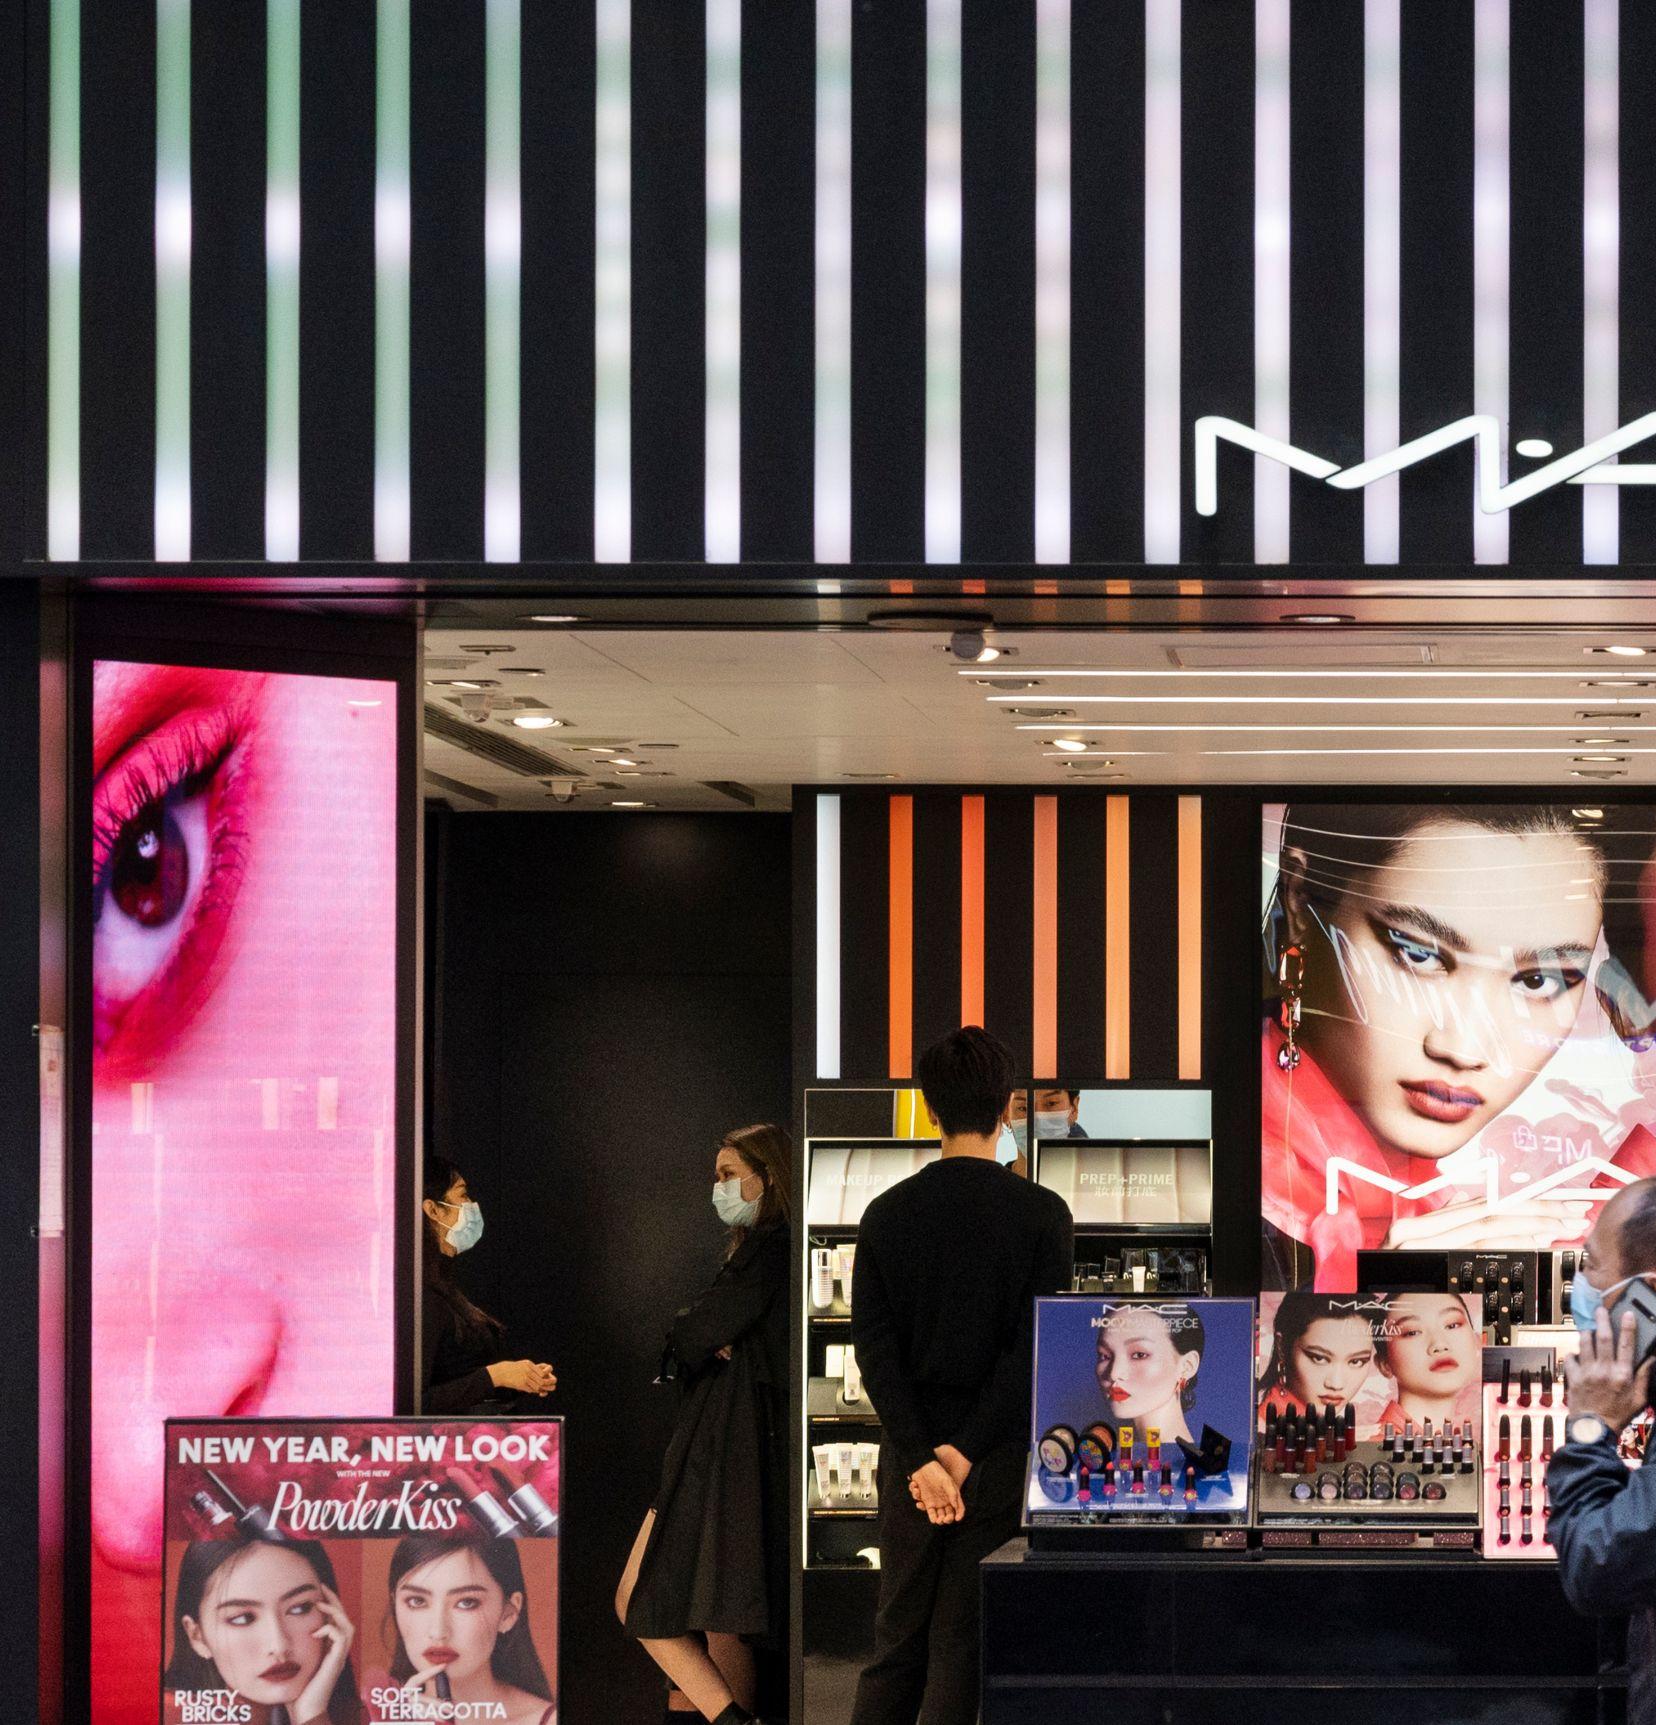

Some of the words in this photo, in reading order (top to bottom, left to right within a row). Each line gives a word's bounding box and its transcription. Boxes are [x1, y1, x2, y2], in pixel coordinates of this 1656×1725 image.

[179, 1437, 253, 1464] NEW
[262, 1437, 362, 1467] YEAR,
[372, 1436, 447, 1462] NEW
[455, 1435, 550, 1462] LOOK
[266, 1480, 462, 1532] PowderKiss
[174, 1690, 239, 1707] RUSTY
[371, 1688, 425, 1705] SOFT
[181, 1706, 251, 1722] BRICKS
[378, 1703, 507, 1720] TERRACOTTA
